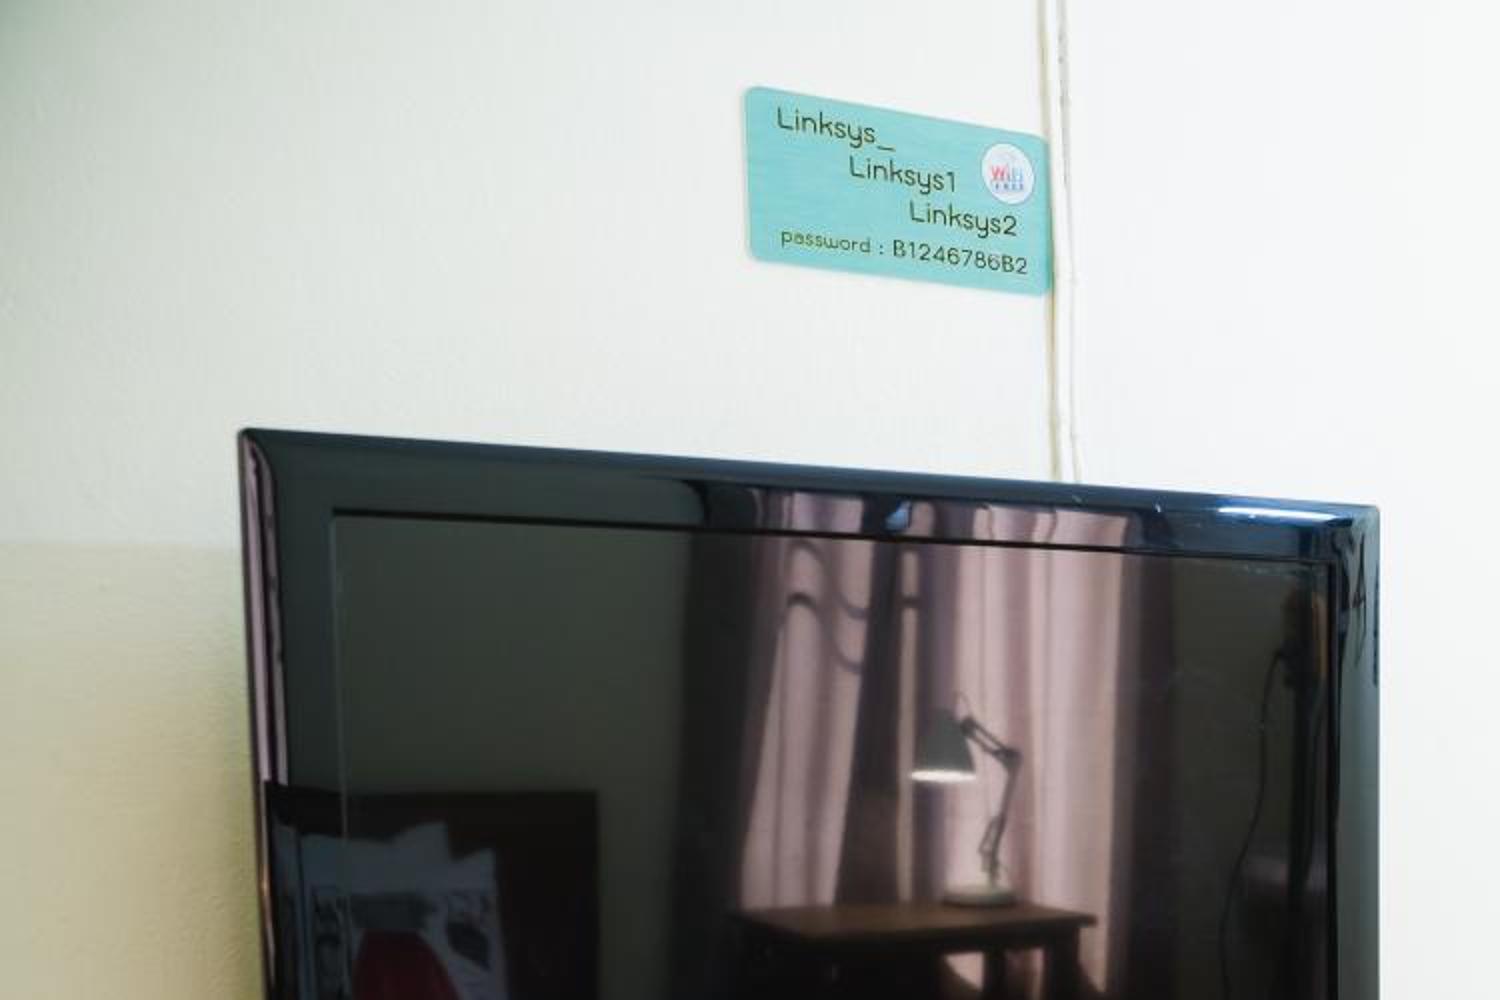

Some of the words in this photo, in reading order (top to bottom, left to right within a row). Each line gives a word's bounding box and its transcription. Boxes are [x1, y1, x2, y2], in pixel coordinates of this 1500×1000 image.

[777, 107, 895, 151] Linksys_
[850, 156, 956, 194] Linksys1
[911, 201, 1017, 238] Linksys2
[781, 231, 870, 253] password
